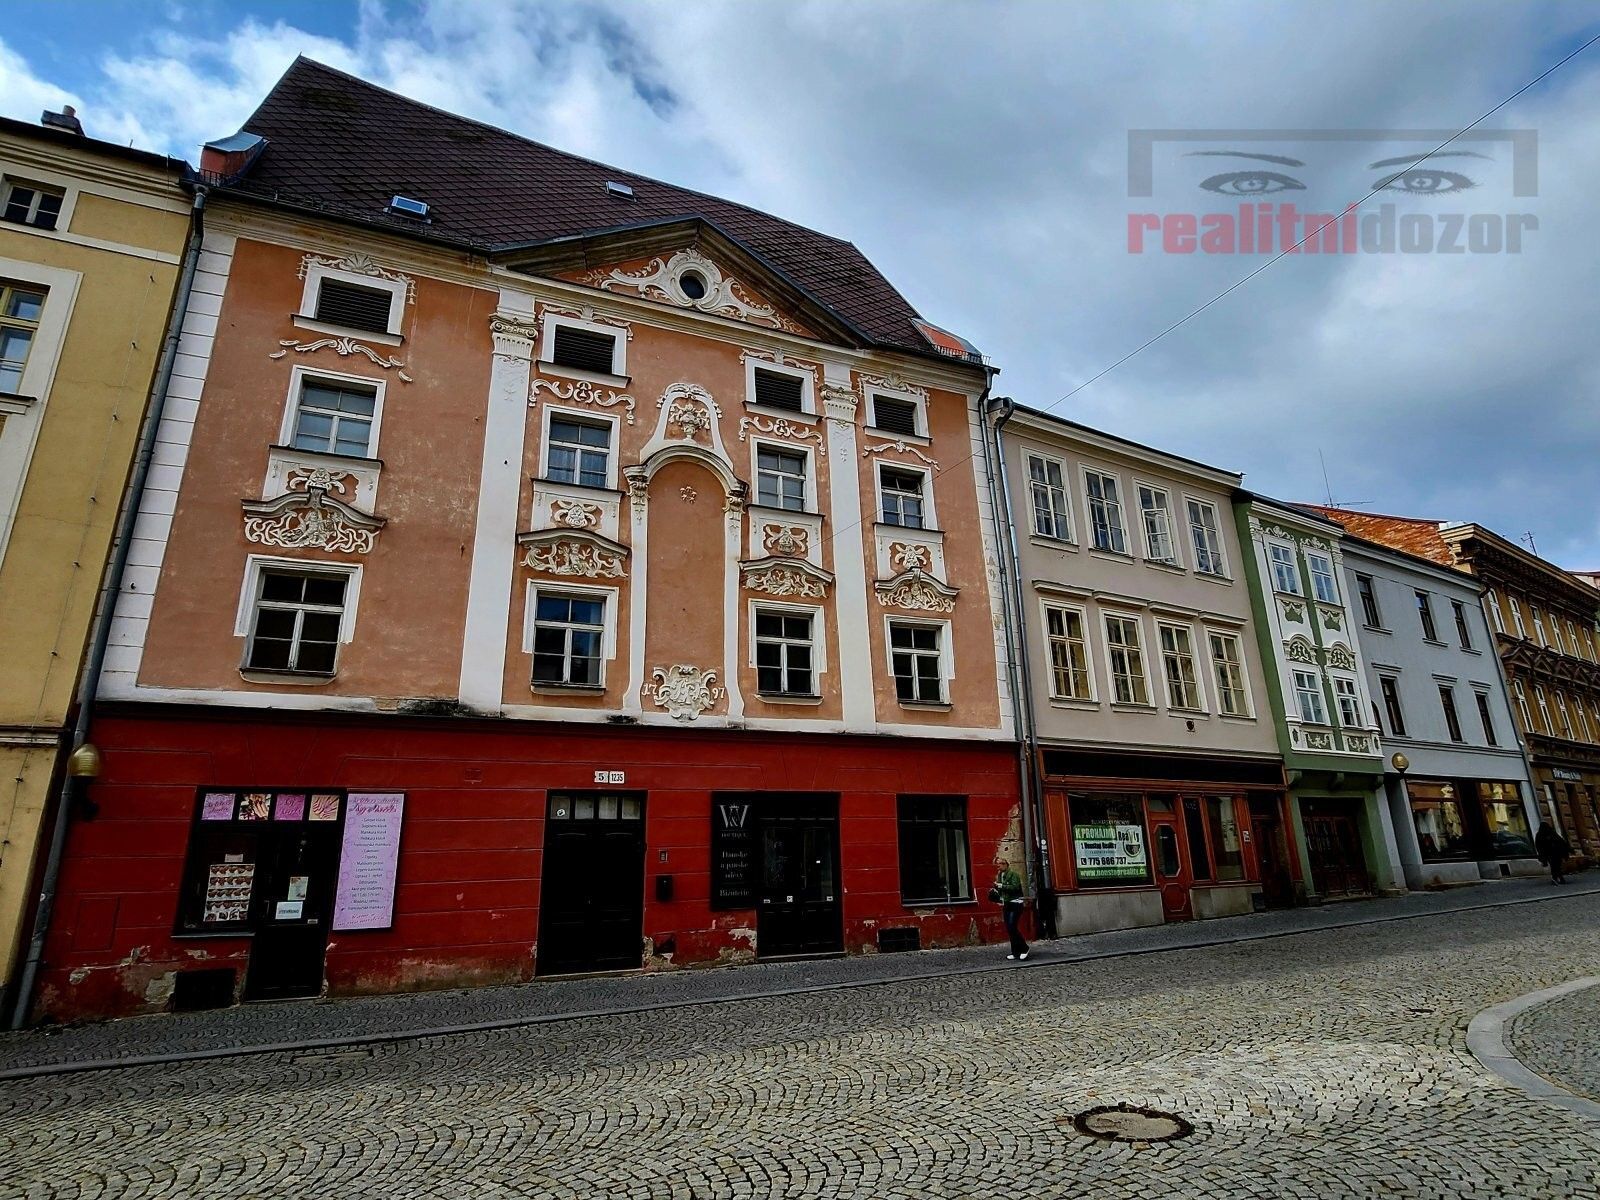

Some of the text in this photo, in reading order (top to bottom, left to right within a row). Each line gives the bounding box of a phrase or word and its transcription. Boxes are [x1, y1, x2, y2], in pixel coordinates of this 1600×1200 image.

[598, 772, 605, 781] 5
[1075, 828, 1081, 838] K
[1088, 857, 1101, 866] 775
